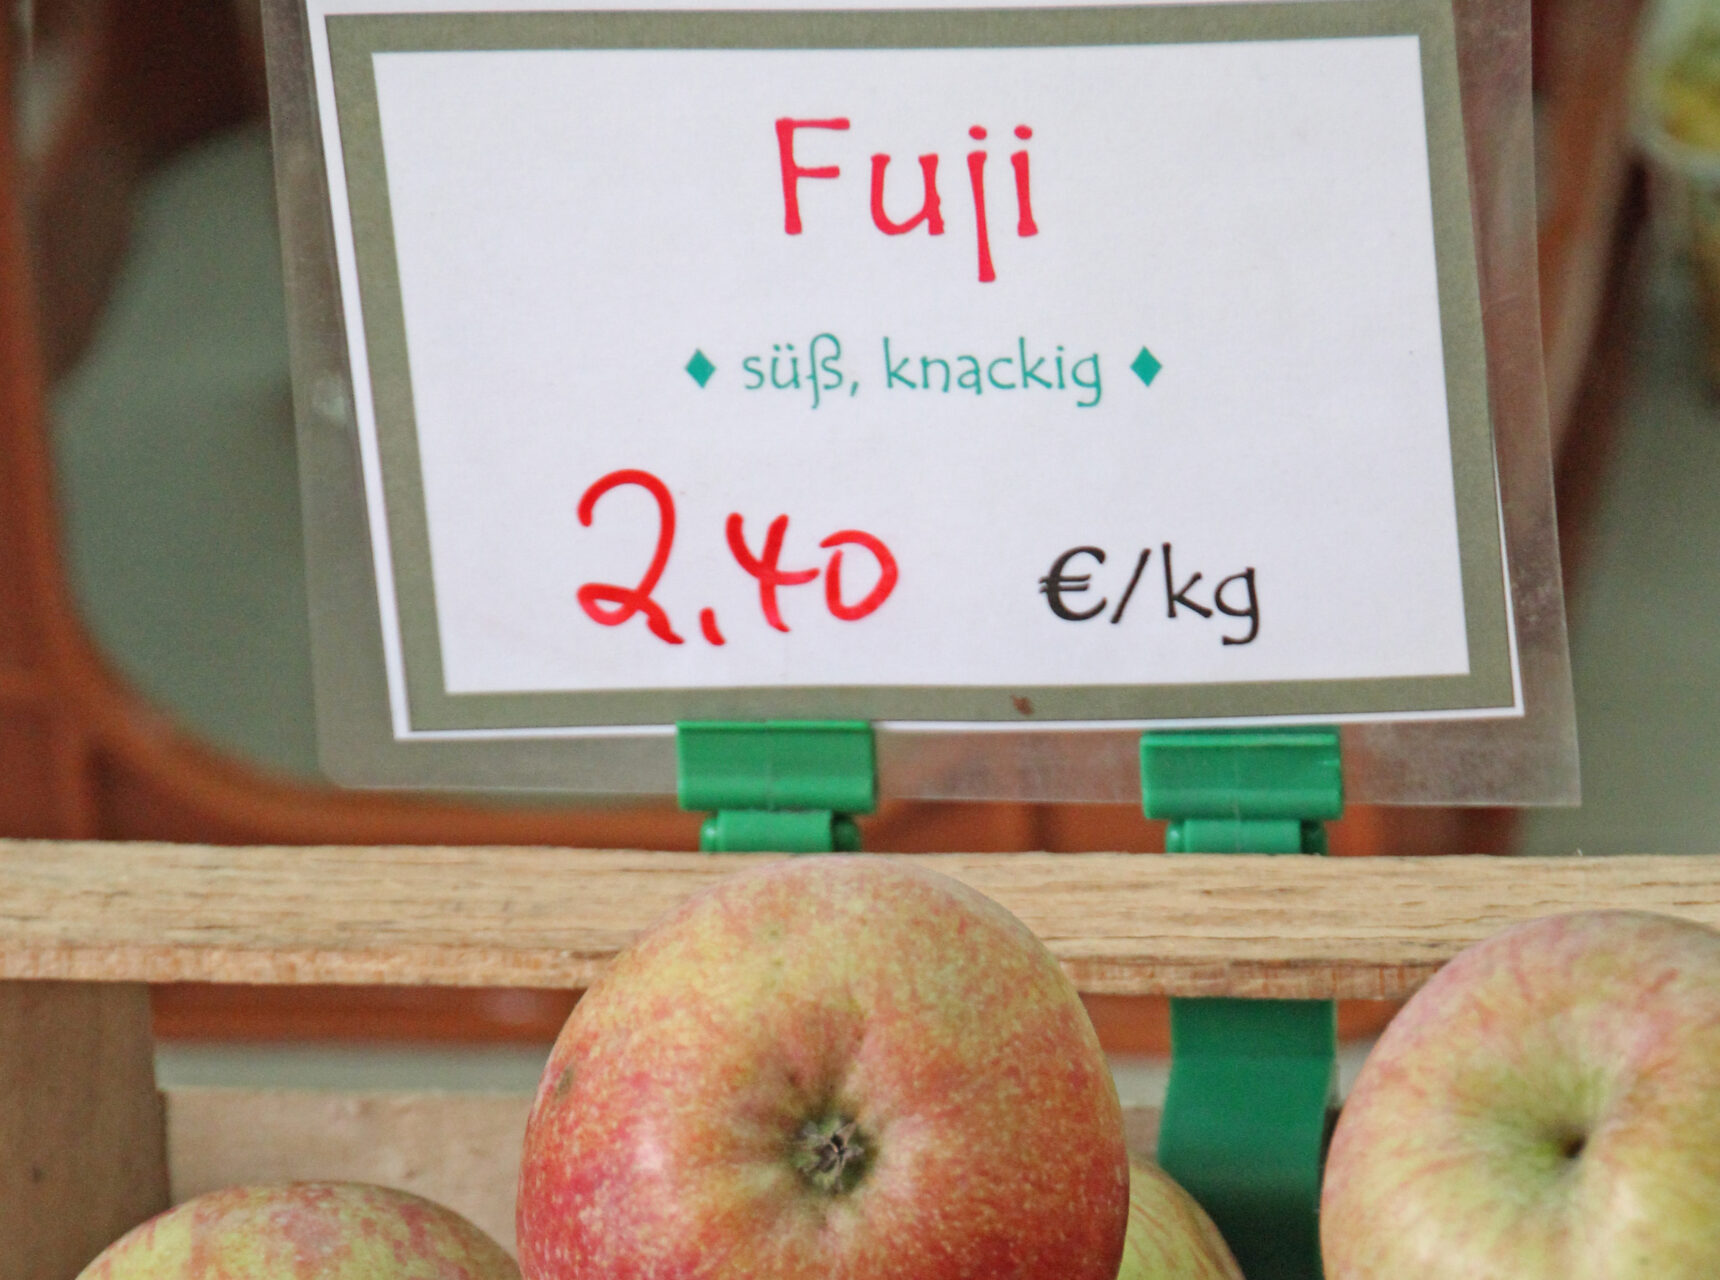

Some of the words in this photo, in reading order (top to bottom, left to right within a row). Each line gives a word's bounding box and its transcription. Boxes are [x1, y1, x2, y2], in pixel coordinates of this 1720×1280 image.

[773, 116, 1040, 285] Fuji
[741, 331, 860, 409] süß,
[882, 335, 1103, 409] knackig
[1037, 540, 1261, 648] €/kg
